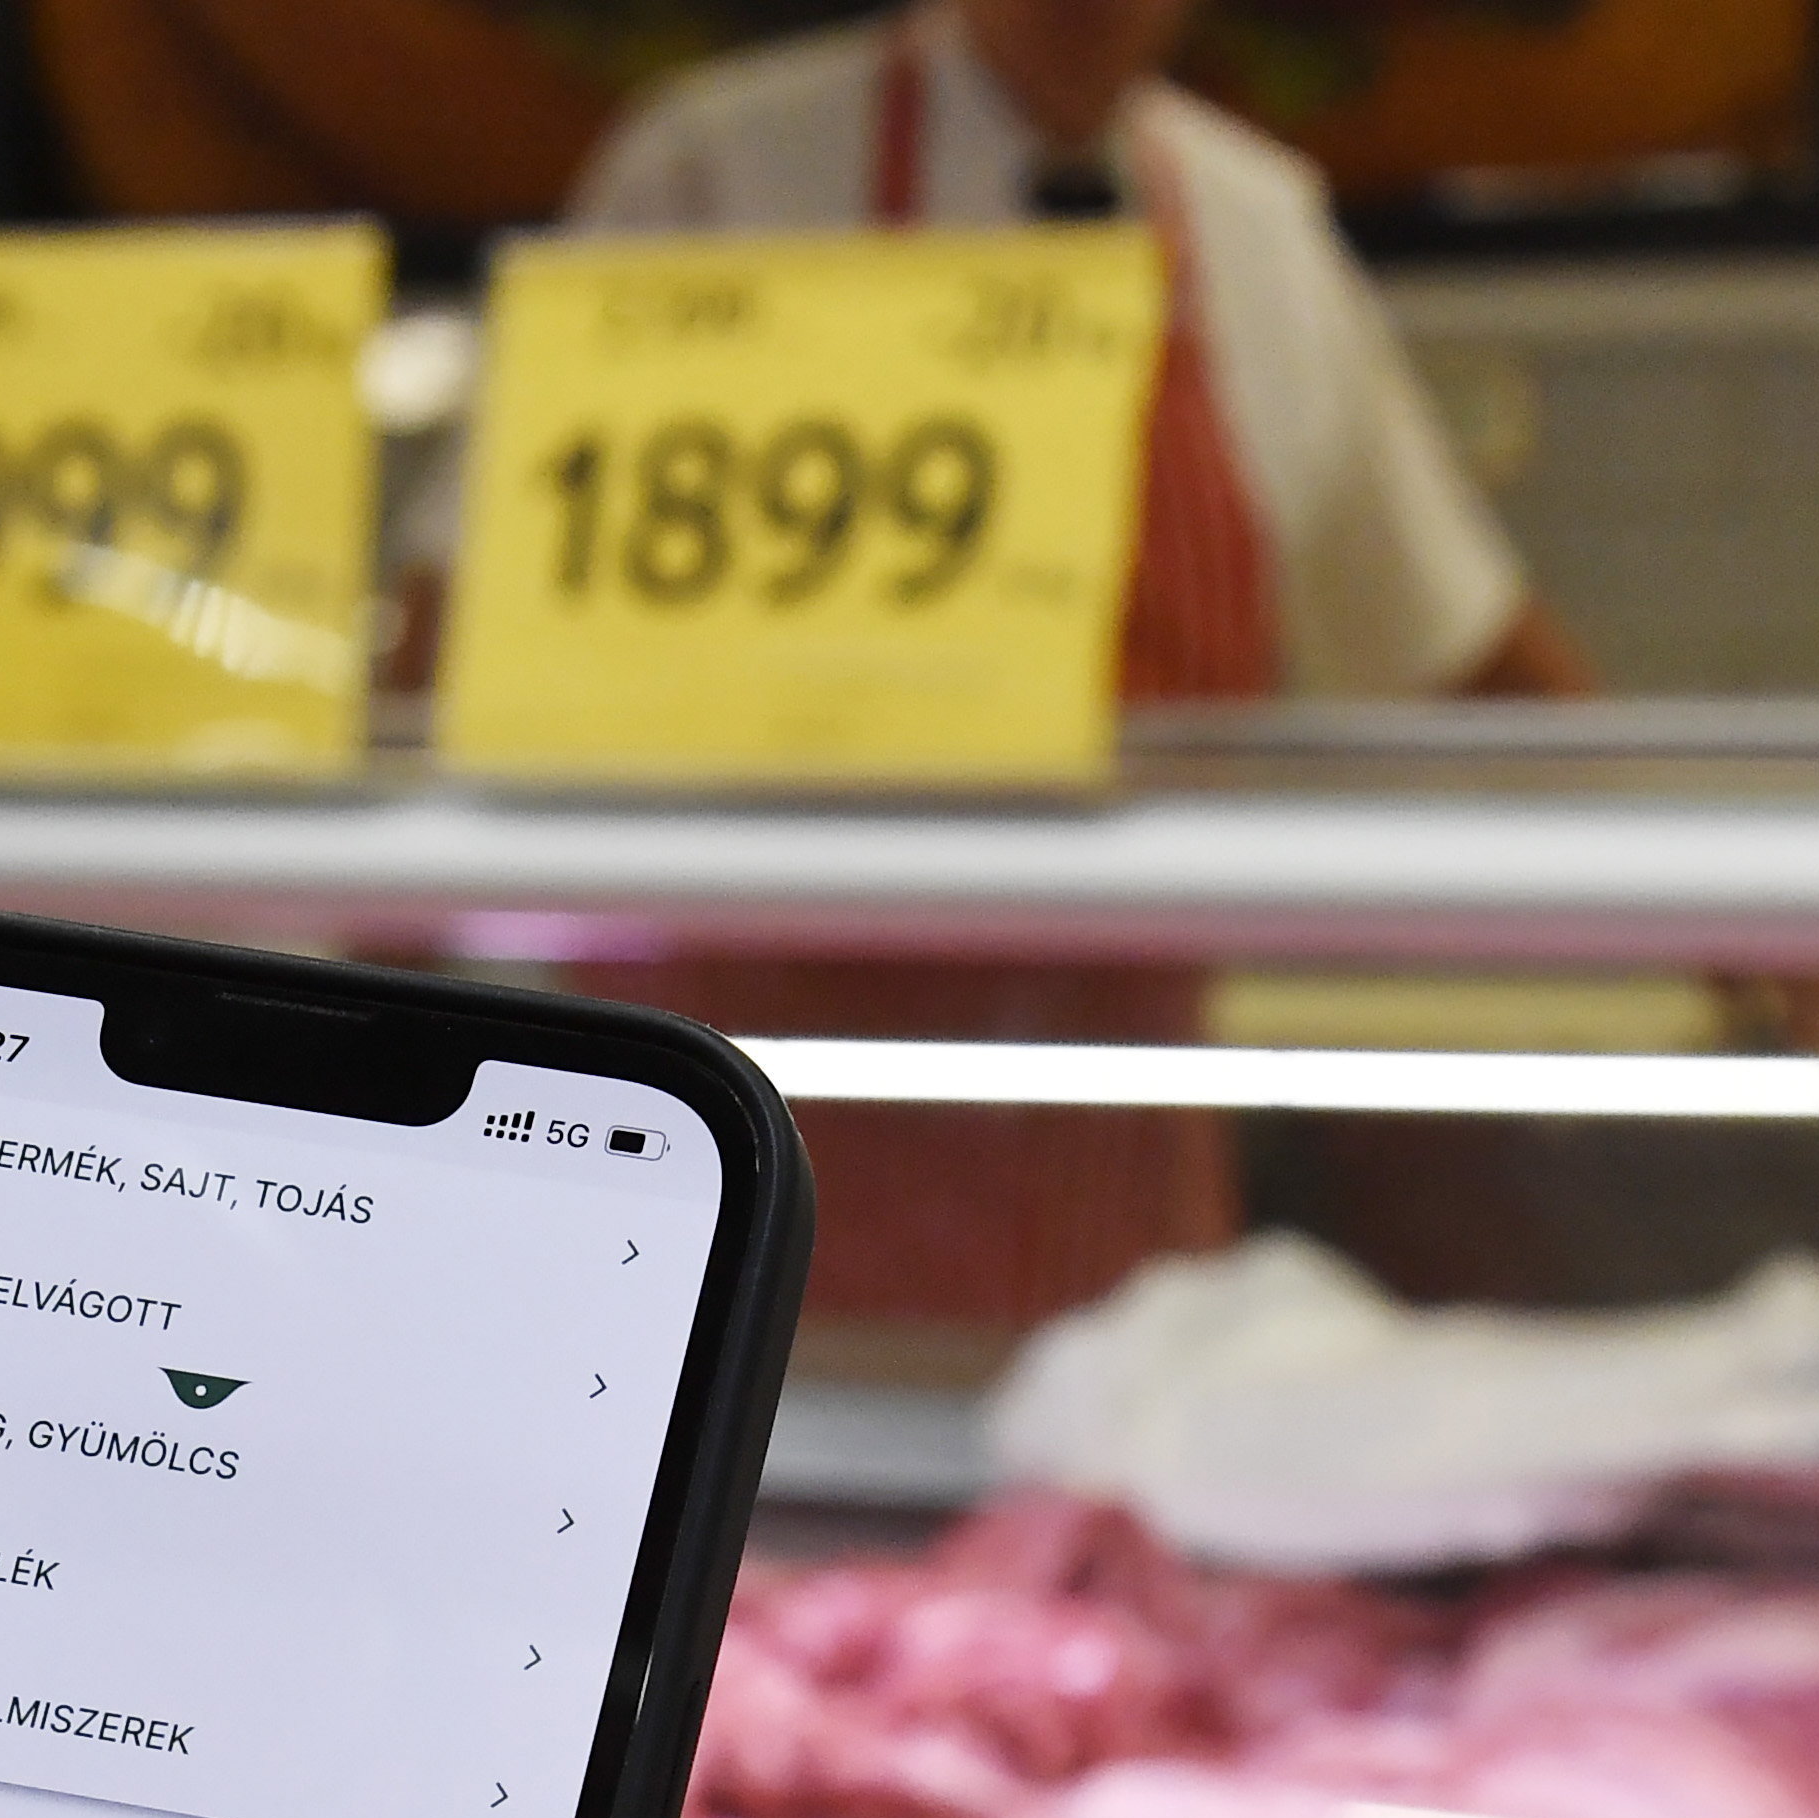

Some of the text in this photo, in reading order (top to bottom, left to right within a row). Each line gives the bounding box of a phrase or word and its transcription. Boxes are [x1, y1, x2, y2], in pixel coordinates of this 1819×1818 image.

[532, 410, 998, 607] 1899
[546, 1119, 590, 1149] 5G
[140, 1163, 238, 1210] SAJT,
[256, 1179, 374, 1224] TOJÁS
[28, 1420, 240, 1480] GYÜMÖLCS
